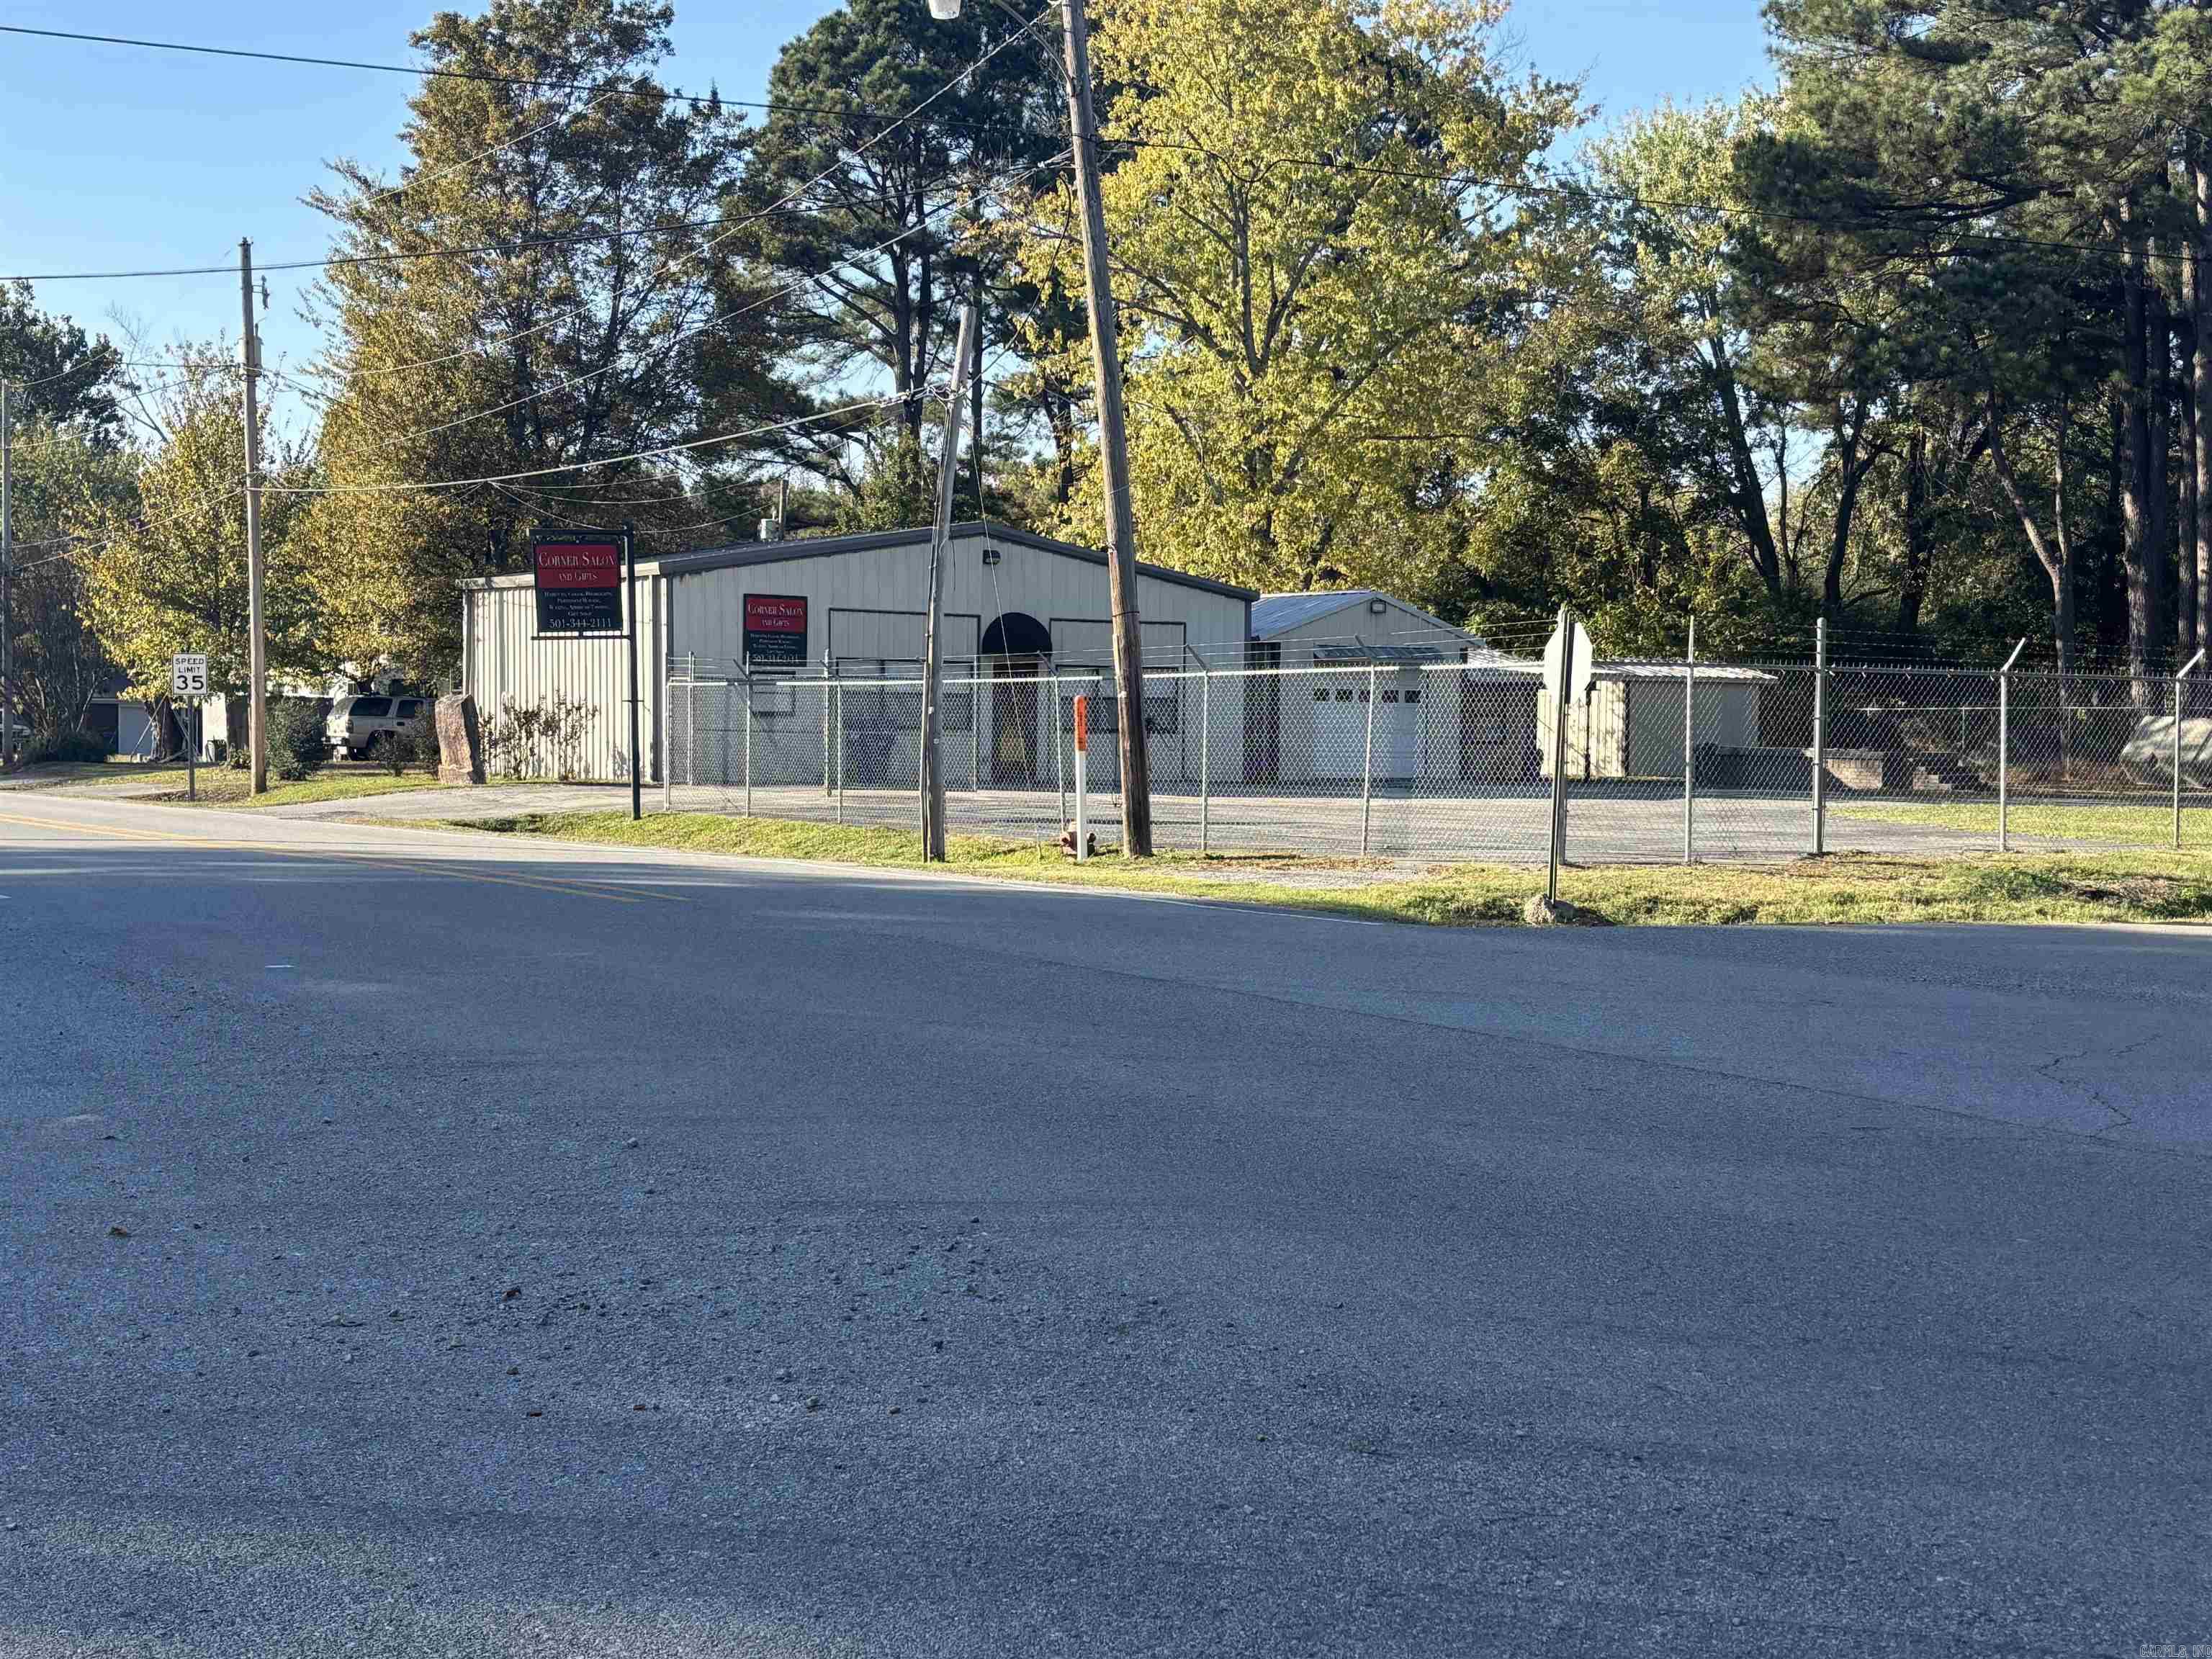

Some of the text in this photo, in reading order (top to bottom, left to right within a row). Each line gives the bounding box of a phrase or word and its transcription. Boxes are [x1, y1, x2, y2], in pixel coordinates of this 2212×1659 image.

[539, 552, 616, 567] CORNER SALON
[575, 572, 598, 581] GIFTS
[748, 603, 804, 616] CORNER SALON
[176, 675, 204, 691] 35
